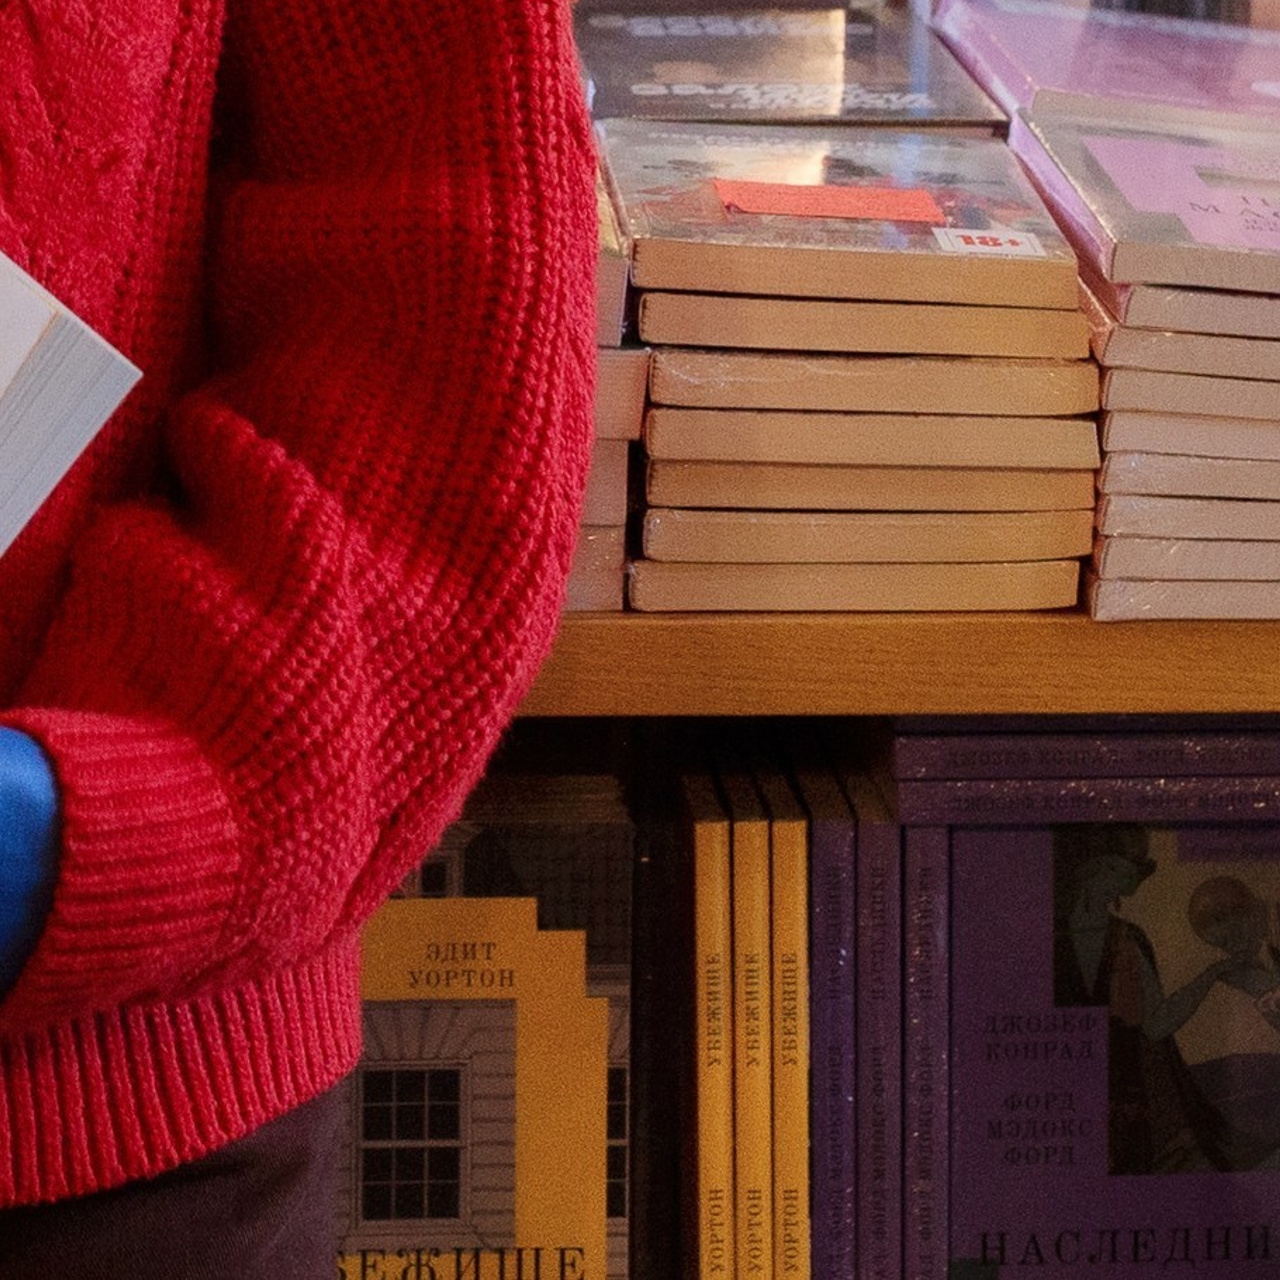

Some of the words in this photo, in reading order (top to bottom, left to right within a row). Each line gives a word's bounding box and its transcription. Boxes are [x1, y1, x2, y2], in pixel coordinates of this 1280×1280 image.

[408, 969, 514, 989] УОРТОН
[425, 942, 497, 964] ЭДИТ
[707, 953, 723, 1068] УБЕЖИЩЕ
[744, 953, 760, 1068] УБЕЖИЩЕ
[782, 953, 798, 1068] УБЕЖИЩЕ
[985, 1013, 1097, 1035] ДЖОЗЕФ
[986, 1040, 1094, 1062] КОНРАД
[708, 1188, 724, 1274] УОРТОН
[746, 1188, 762, 1274] УОРТОН
[783, 1188, 800, 1274] УОРТОН
[978, 1223, 1271, 1266] НАСЛЕДНИ
